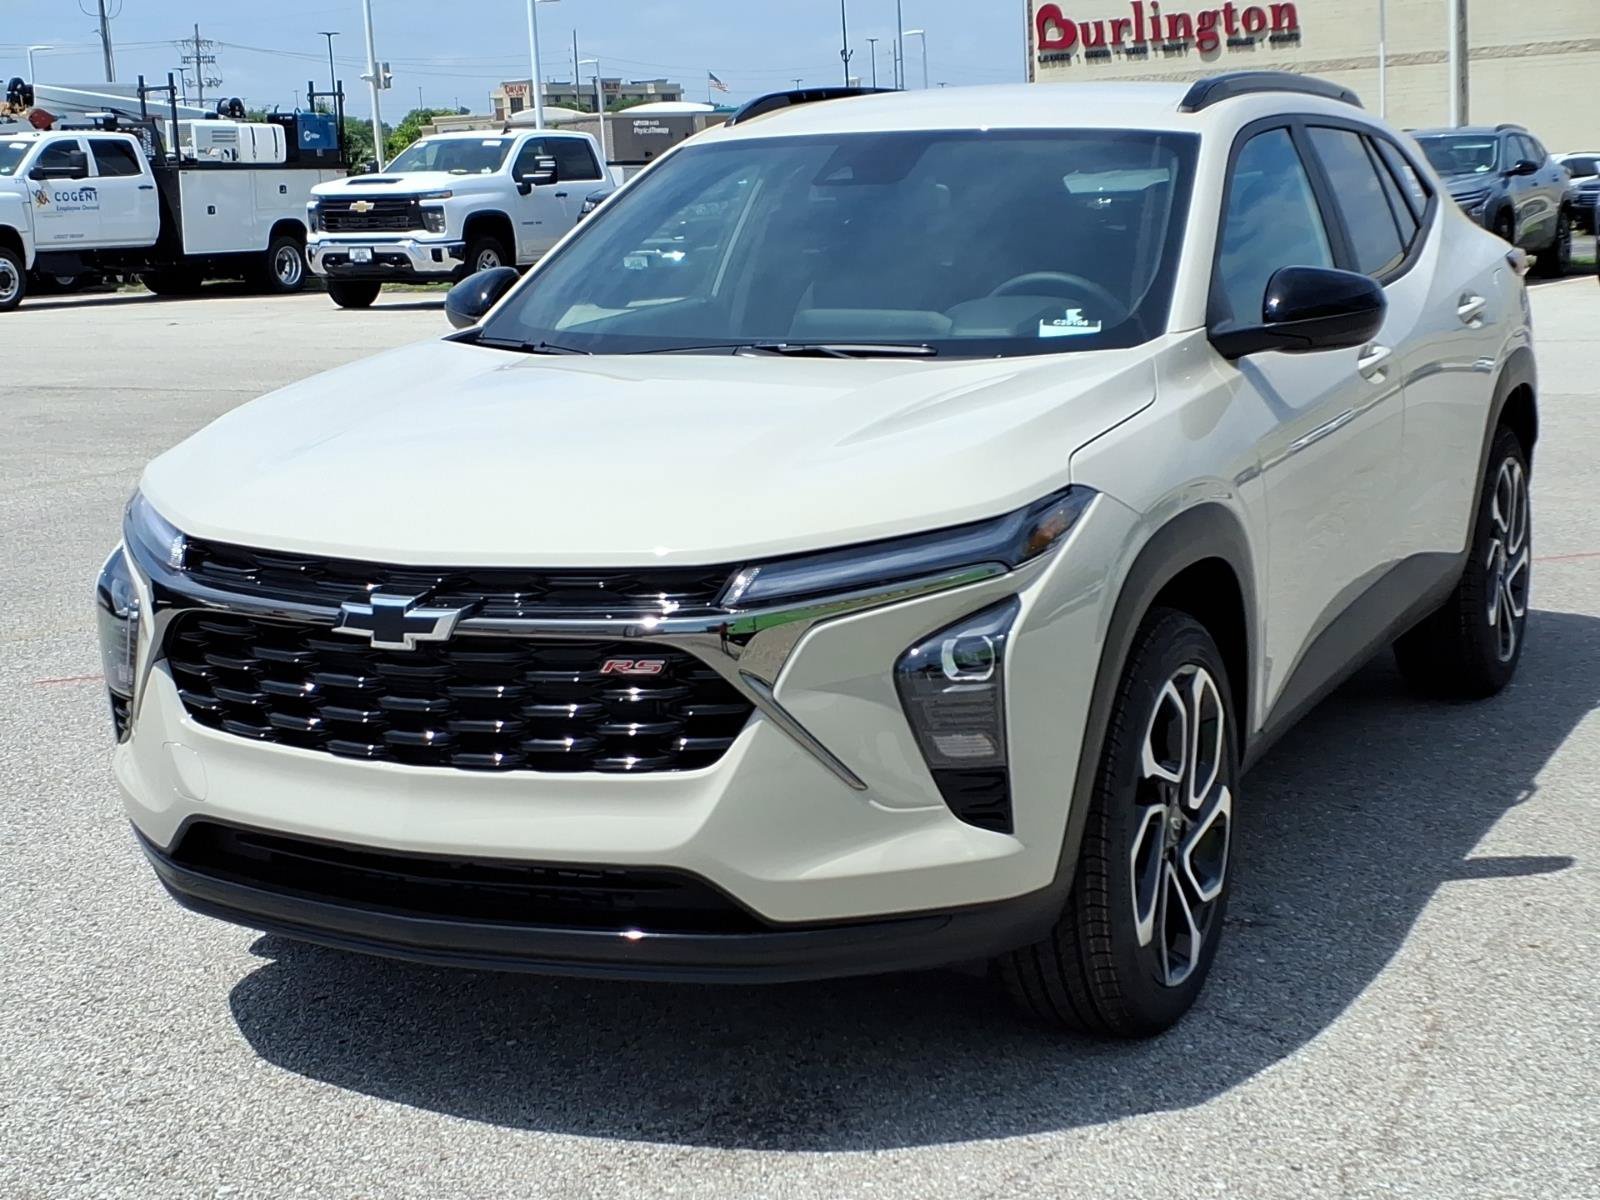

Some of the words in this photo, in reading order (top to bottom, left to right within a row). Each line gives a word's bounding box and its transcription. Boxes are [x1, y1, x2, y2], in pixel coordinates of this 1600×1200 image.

[1036, 1, 1299, 54] Burlington
[54, 191, 98, 202] COGENT
[600, 659, 666, 674] RS
